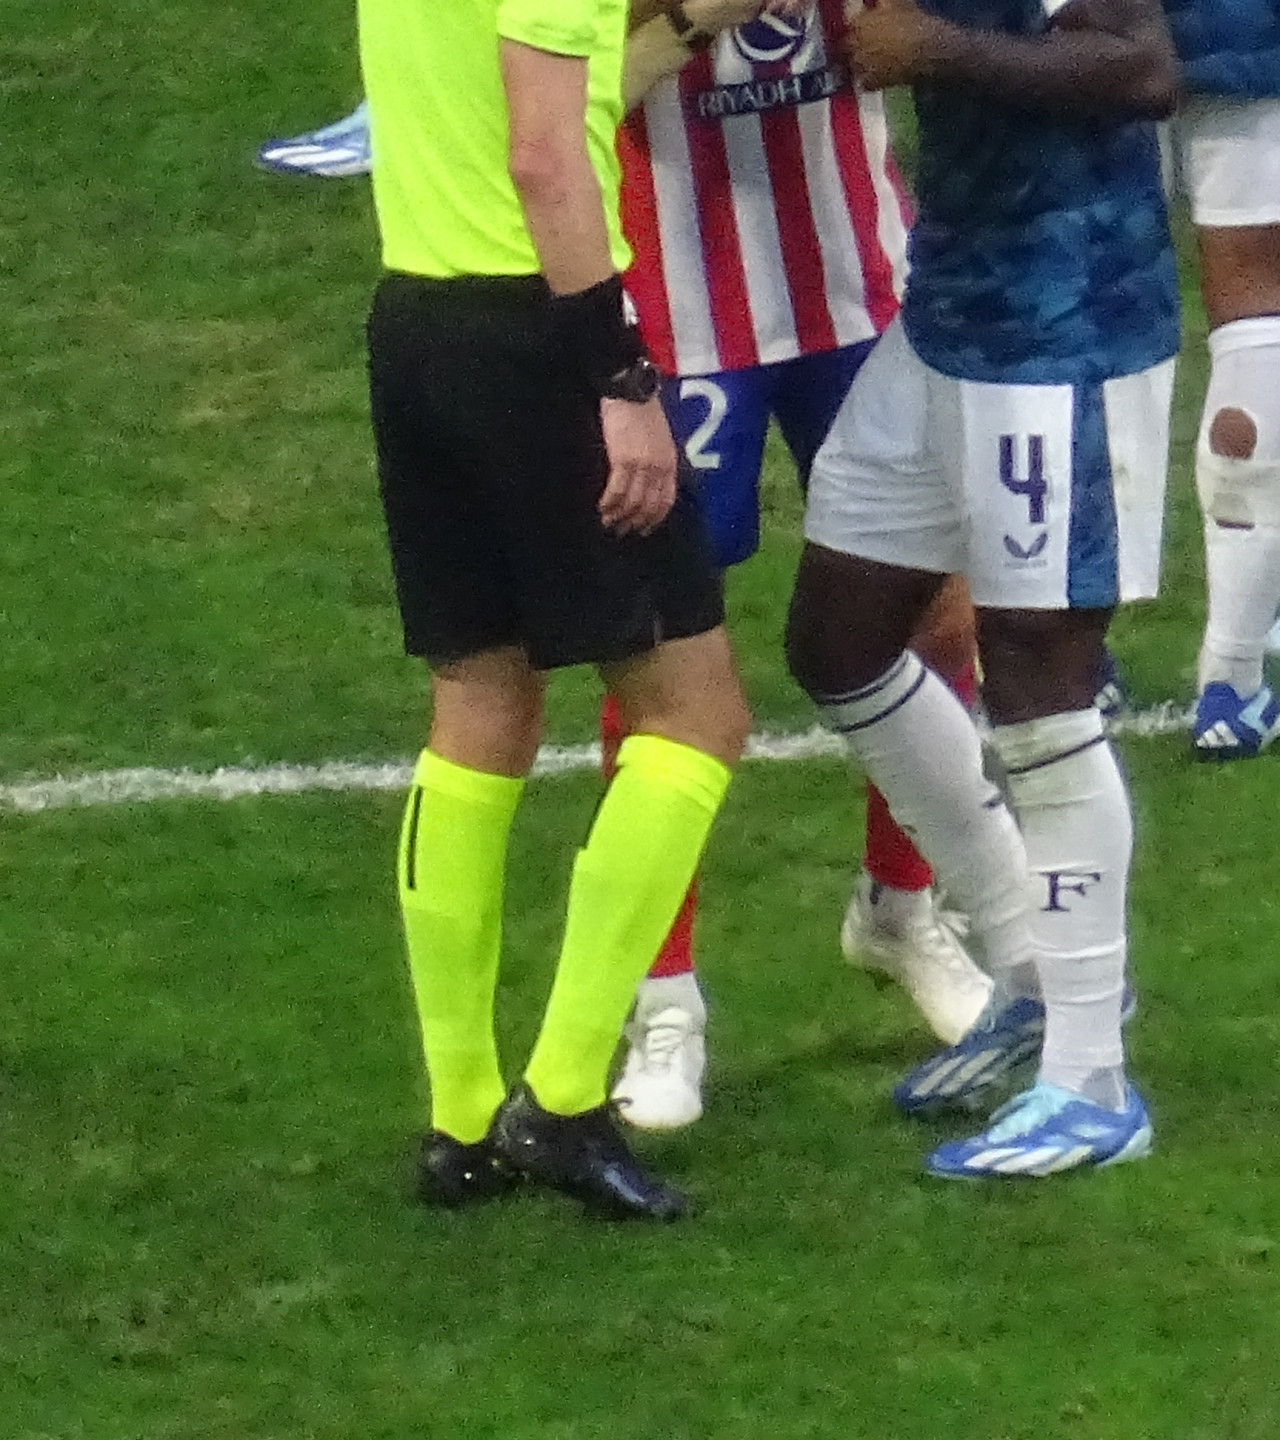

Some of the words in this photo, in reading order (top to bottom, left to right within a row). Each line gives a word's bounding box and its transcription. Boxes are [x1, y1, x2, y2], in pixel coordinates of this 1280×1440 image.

[679, 379, 728, 469] 2
[1000, 433, 1047, 523] 4
[1039, 870, 1101, 912] F
